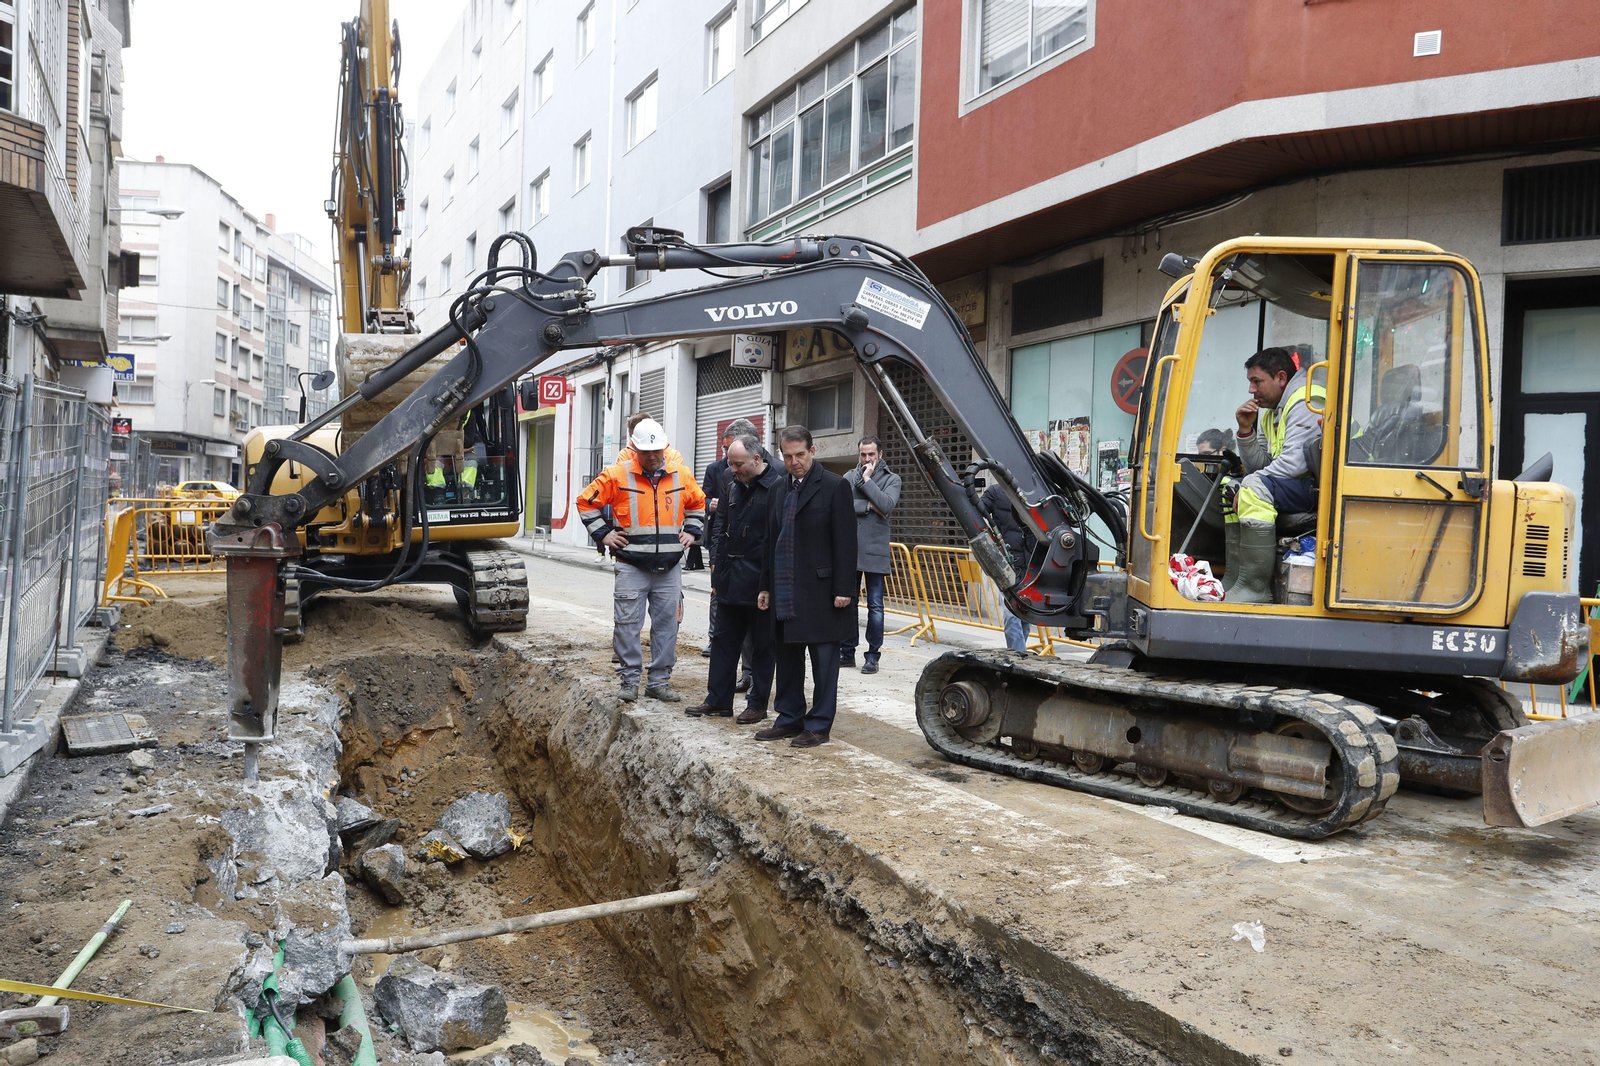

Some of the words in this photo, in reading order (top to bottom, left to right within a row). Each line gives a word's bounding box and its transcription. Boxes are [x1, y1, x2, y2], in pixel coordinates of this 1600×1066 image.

[704, 300, 798, 322] VOLVO
[884, 299, 898, 308] OBRAS
[902, 307, 922, 318] SERVICIOS
[746, 335, 772, 347] GUIA
[805, 328, 826, 360] A
[114, 372, 134, 381] NTILES
[428, 513, 449, 521] RAMA
[1432, 630, 1496, 653] EC50
